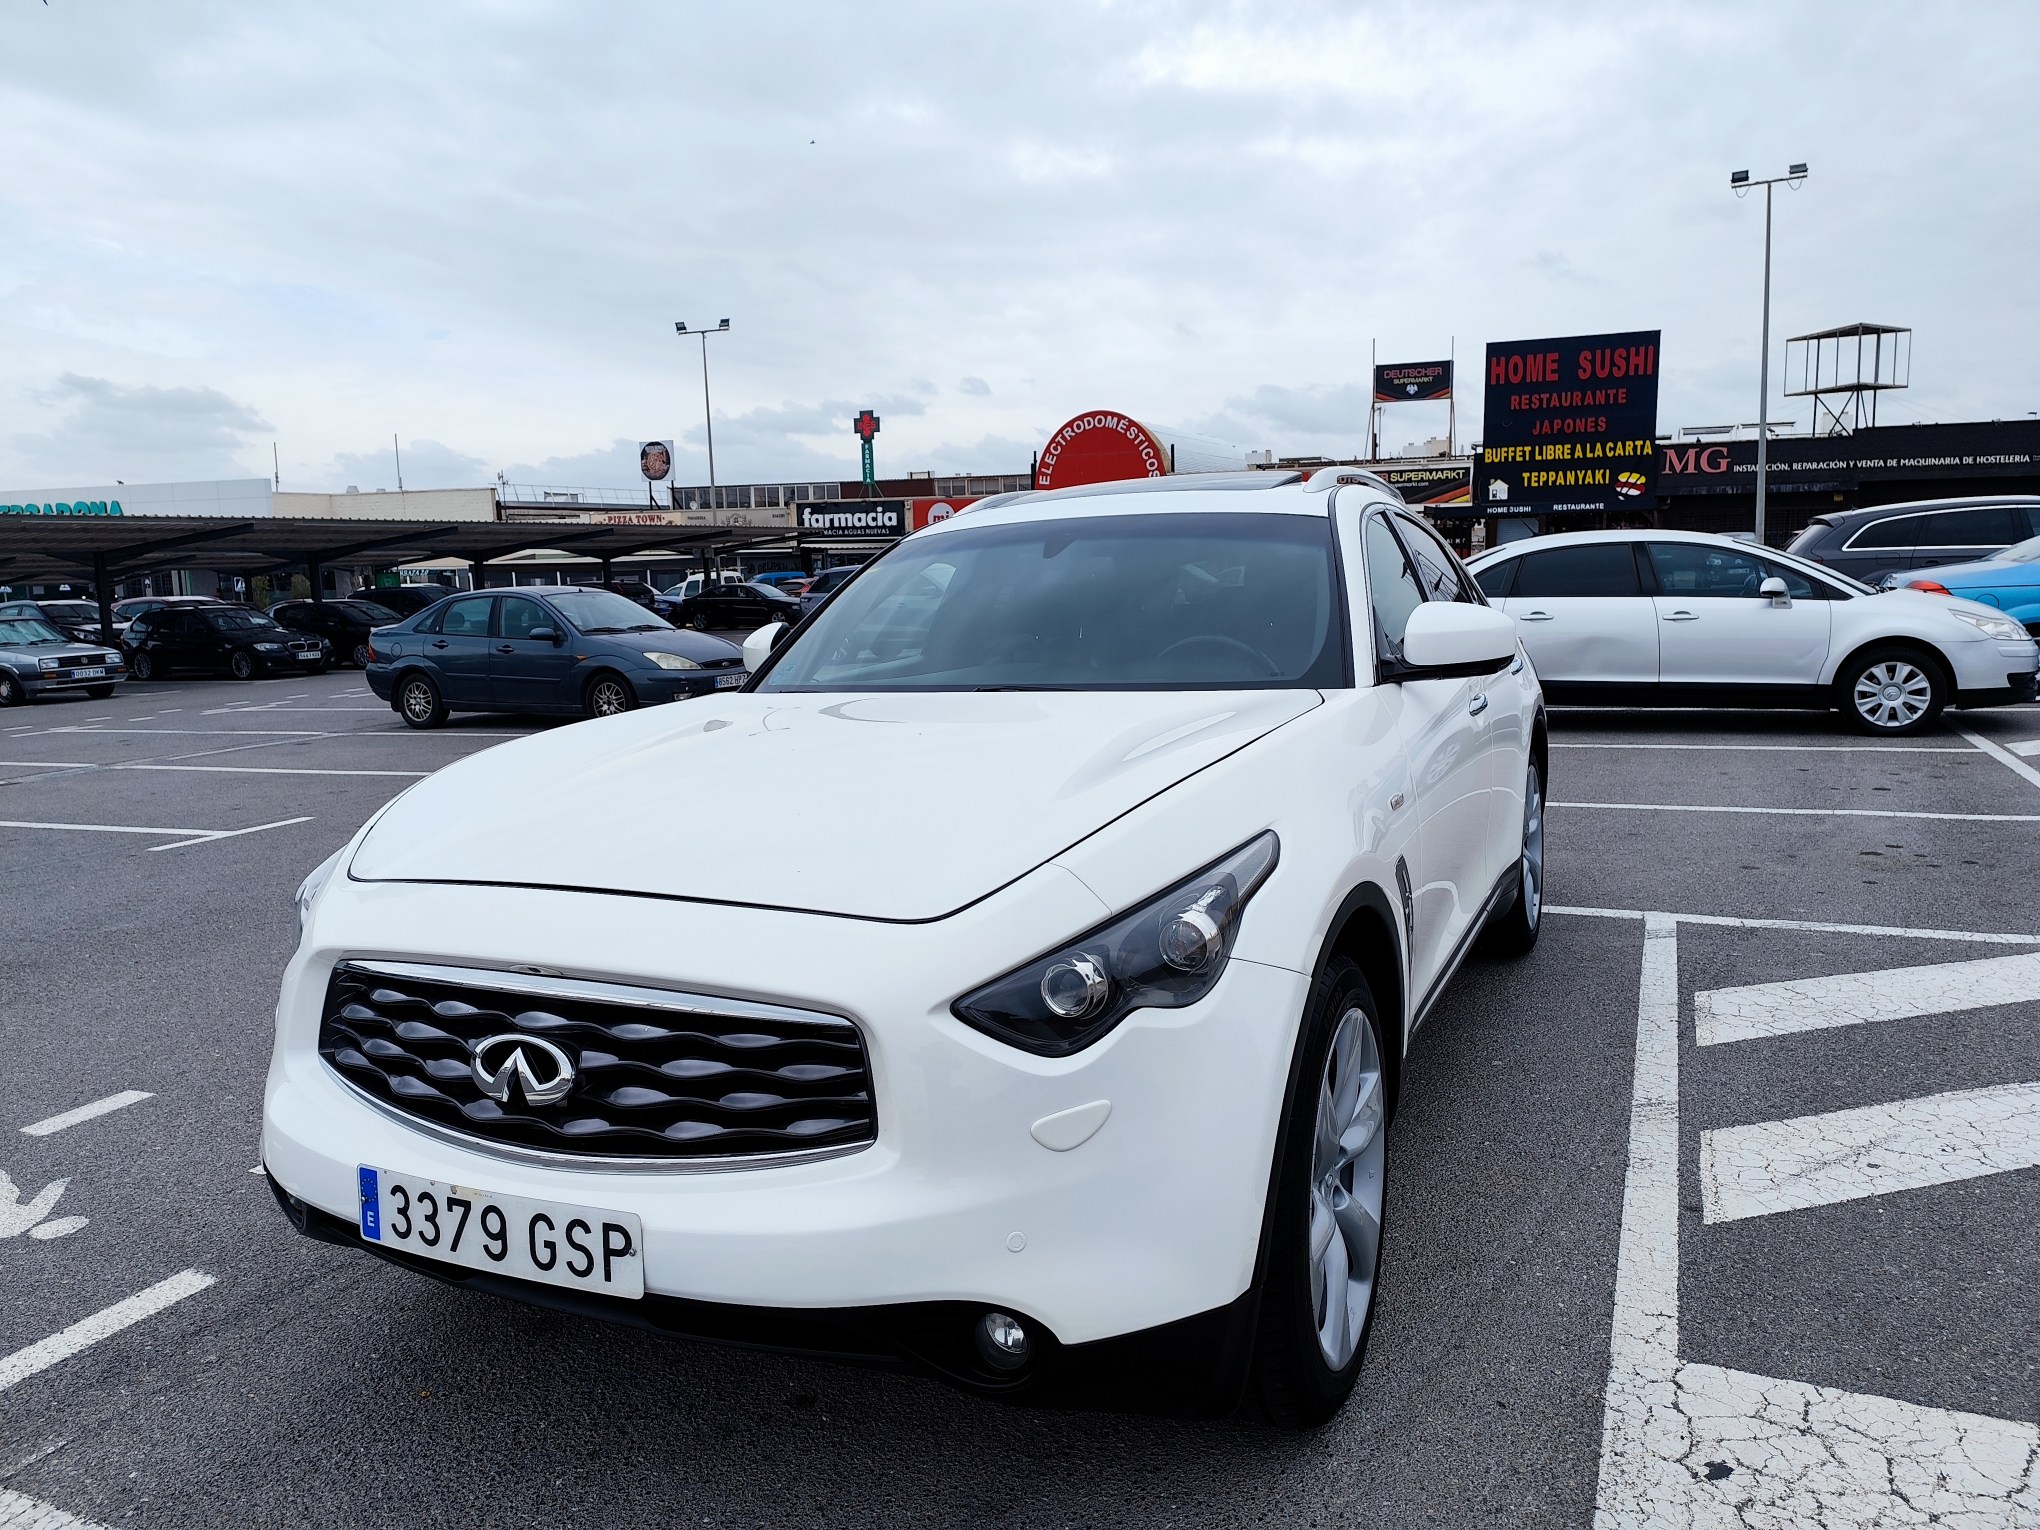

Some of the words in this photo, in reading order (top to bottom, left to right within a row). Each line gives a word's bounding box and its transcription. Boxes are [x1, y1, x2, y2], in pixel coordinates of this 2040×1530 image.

[1384, 367, 1443, 379] DEUTSCHER
[1490, 352, 1560, 385] HOME
[1577, 345, 1654, 380] SUSHI
[1393, 377, 1434, 385] SUPERMARKT
[1510, 388, 1627, 410] RESTAURANTE
[1532, 416, 1607, 436] JAPONES
[1039, 415, 1160, 485] ELECTRODOMÉSTICOS
[1484, 446, 1532, 463] BUFFET
[1535, 443, 1571, 461] LIBRE
[1574, 444, 1583, 459] A
[1586, 442, 1603, 458] LA
[1606, 440, 1653, 457] CARTA
[864, 444, 872, 483] FARMACIA
[1661, 446, 1732, 475] MG
[1792, 459, 1847, 471] REPARACIÓN
[1849, 460, 1855, 468] Y
[1856, 459, 1885, 468] VENTA
[1887, 458, 1898, 467] DE
[1900, 456, 1960, 468] MAQUINARIA
[1963, 456, 1974, 465] DE
[1976, 454, 2030, 464] HOSTELERIA
[1390, 470, 1465, 482] SUPERMARKT
[1522, 469, 1610, 487] TEPPANYAKI
[802, 506, 898, 528] farmacia
[1487, 506, 1508, 514] HOME
[1509, 505, 1532, 513] SUSHI
[1553, 502, 1605, 511] RESTAURANTE
[607, 515, 634, 524] PIZZA
[635, 514, 662, 524] TOWN
[844, 528, 865, 536] AGUAS
[865, 528, 890, 536] NUEVAS
[366, 1210, 375, 1228] E
[389, 1184, 508, 1262] 3379
[528, 1212, 633, 1283] GSP
